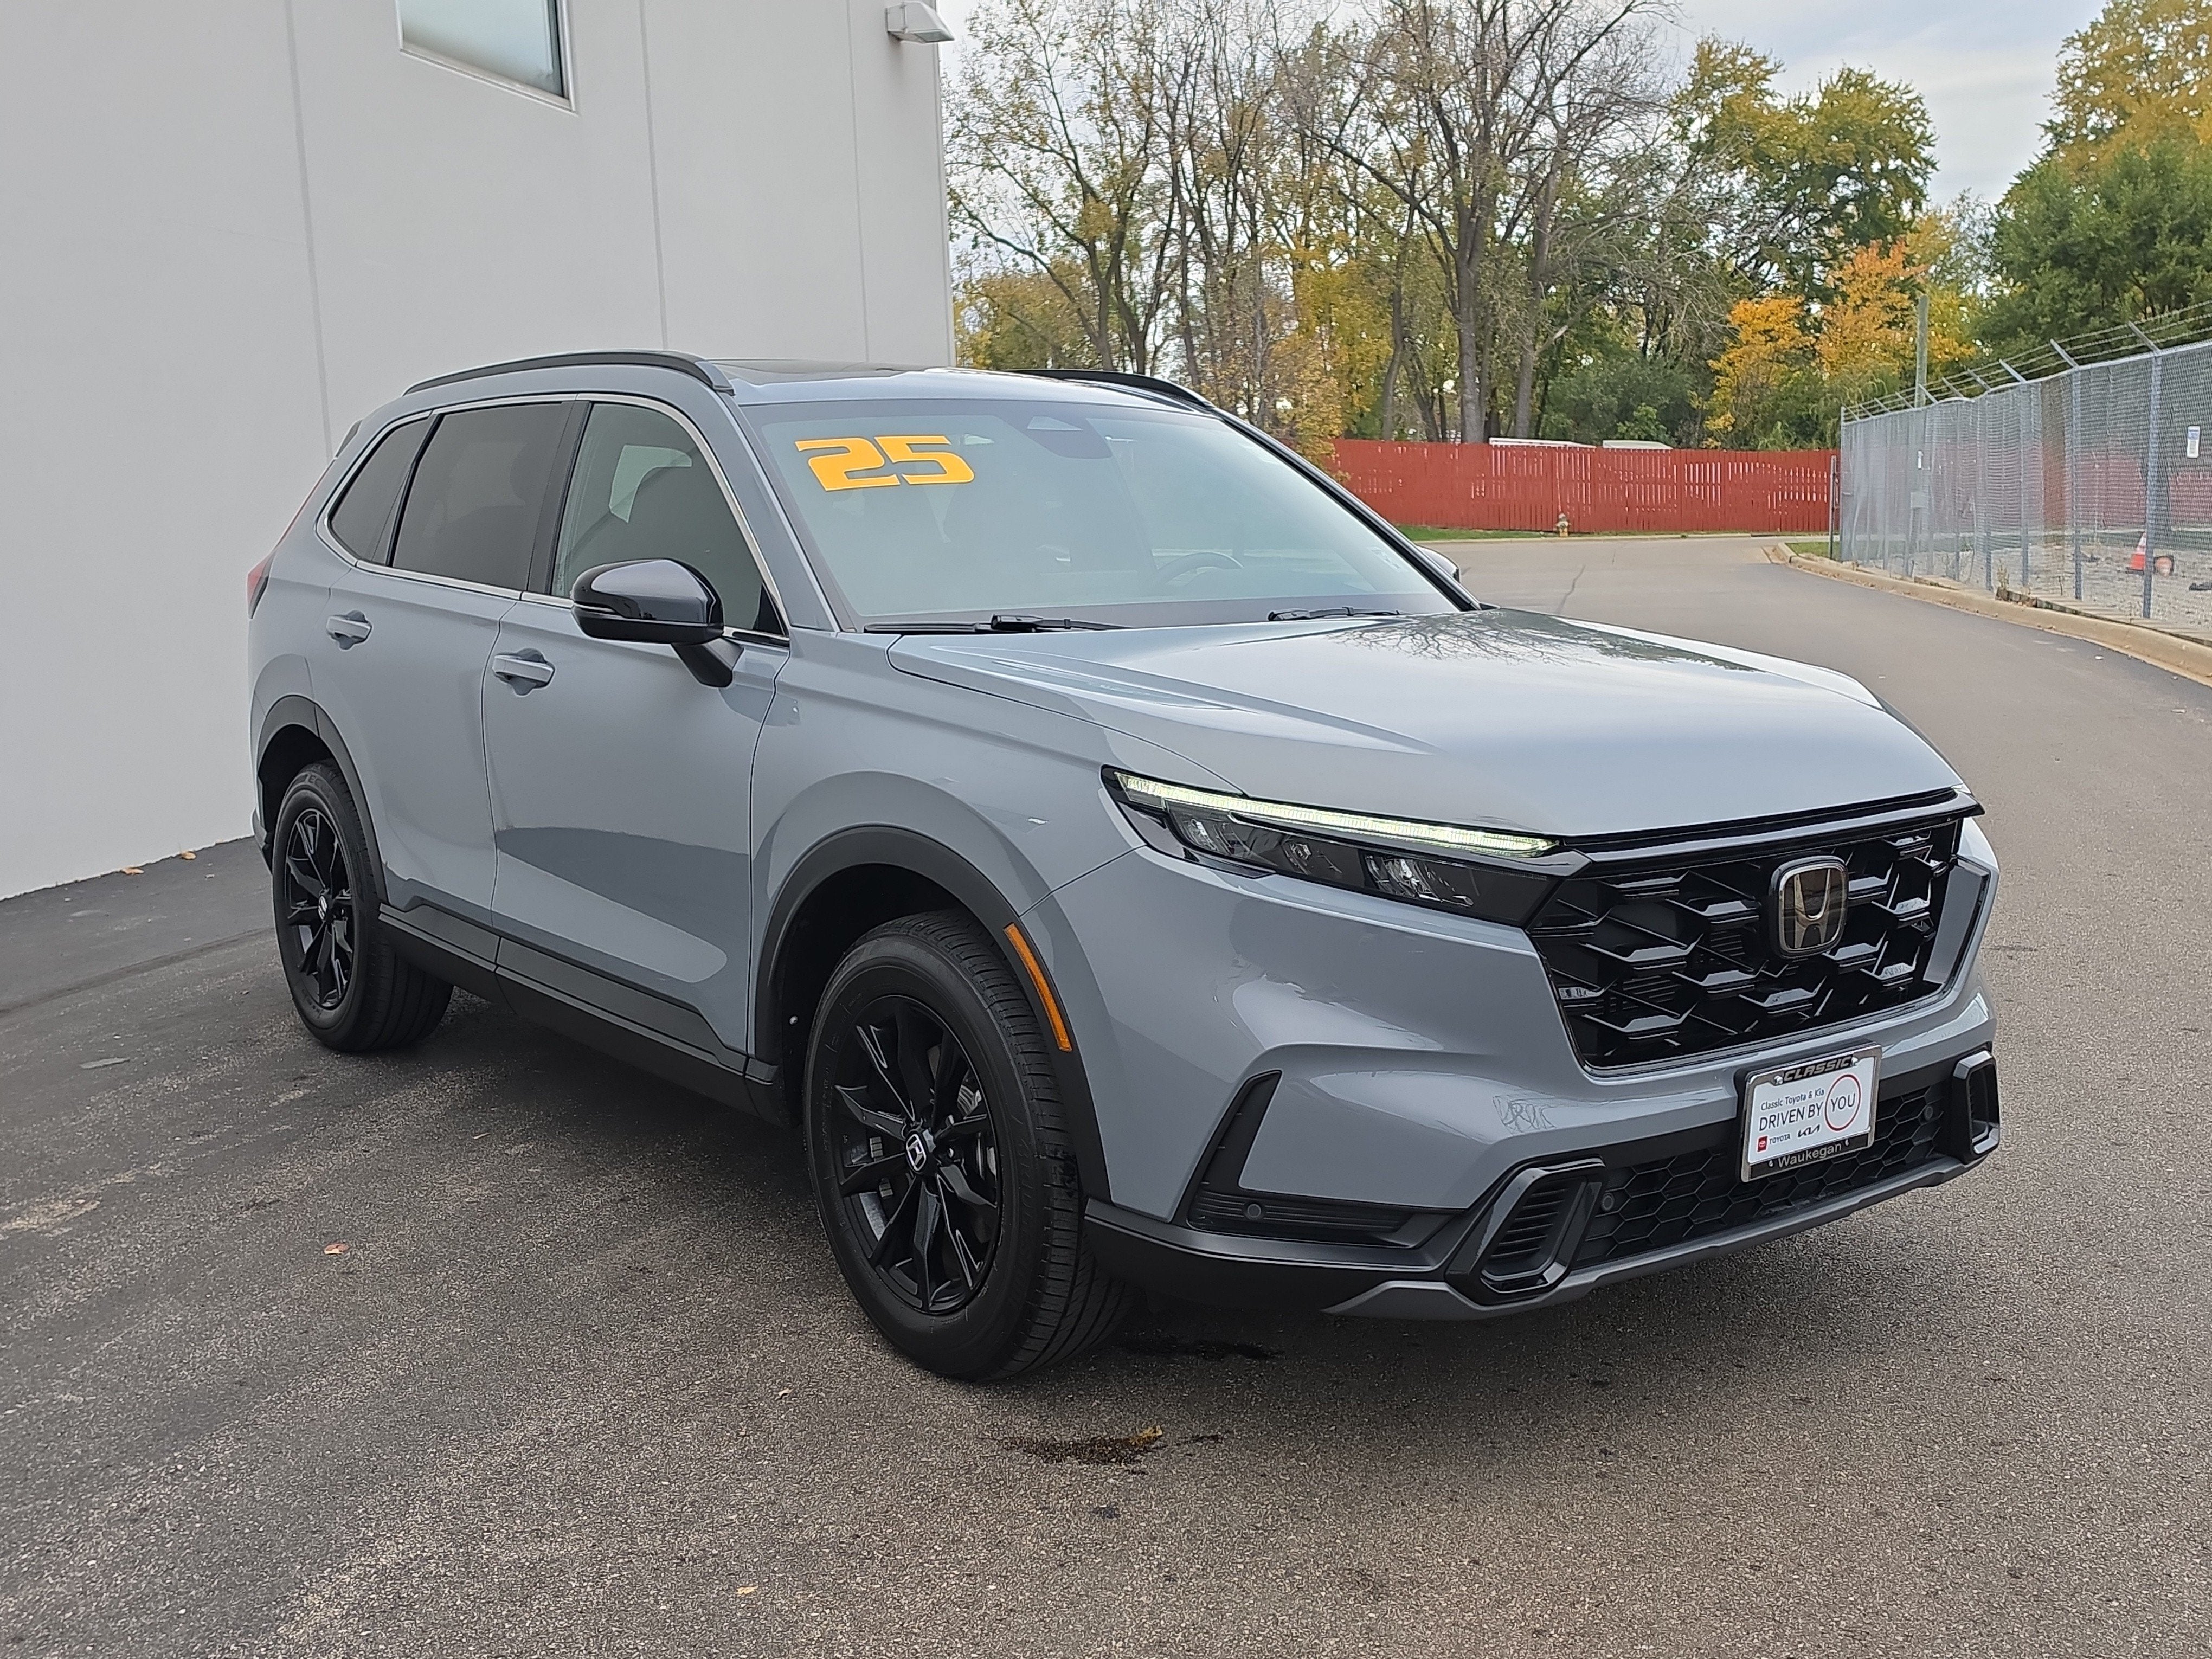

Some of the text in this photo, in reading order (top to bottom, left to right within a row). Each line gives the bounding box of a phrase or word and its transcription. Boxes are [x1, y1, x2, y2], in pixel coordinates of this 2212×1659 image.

[794, 434, 975, 492] 25
[1784, 1056, 1852, 1082] CLASSIC
[1759, 1092, 1856, 1131] DRIVEN BY YOU
[1761, 1088, 1825, 1111] Classic Toyota & Kia
[1769, 1134, 1791, 1145] TOYOTA
[1777, 1143, 1842, 1168] Waukegan
